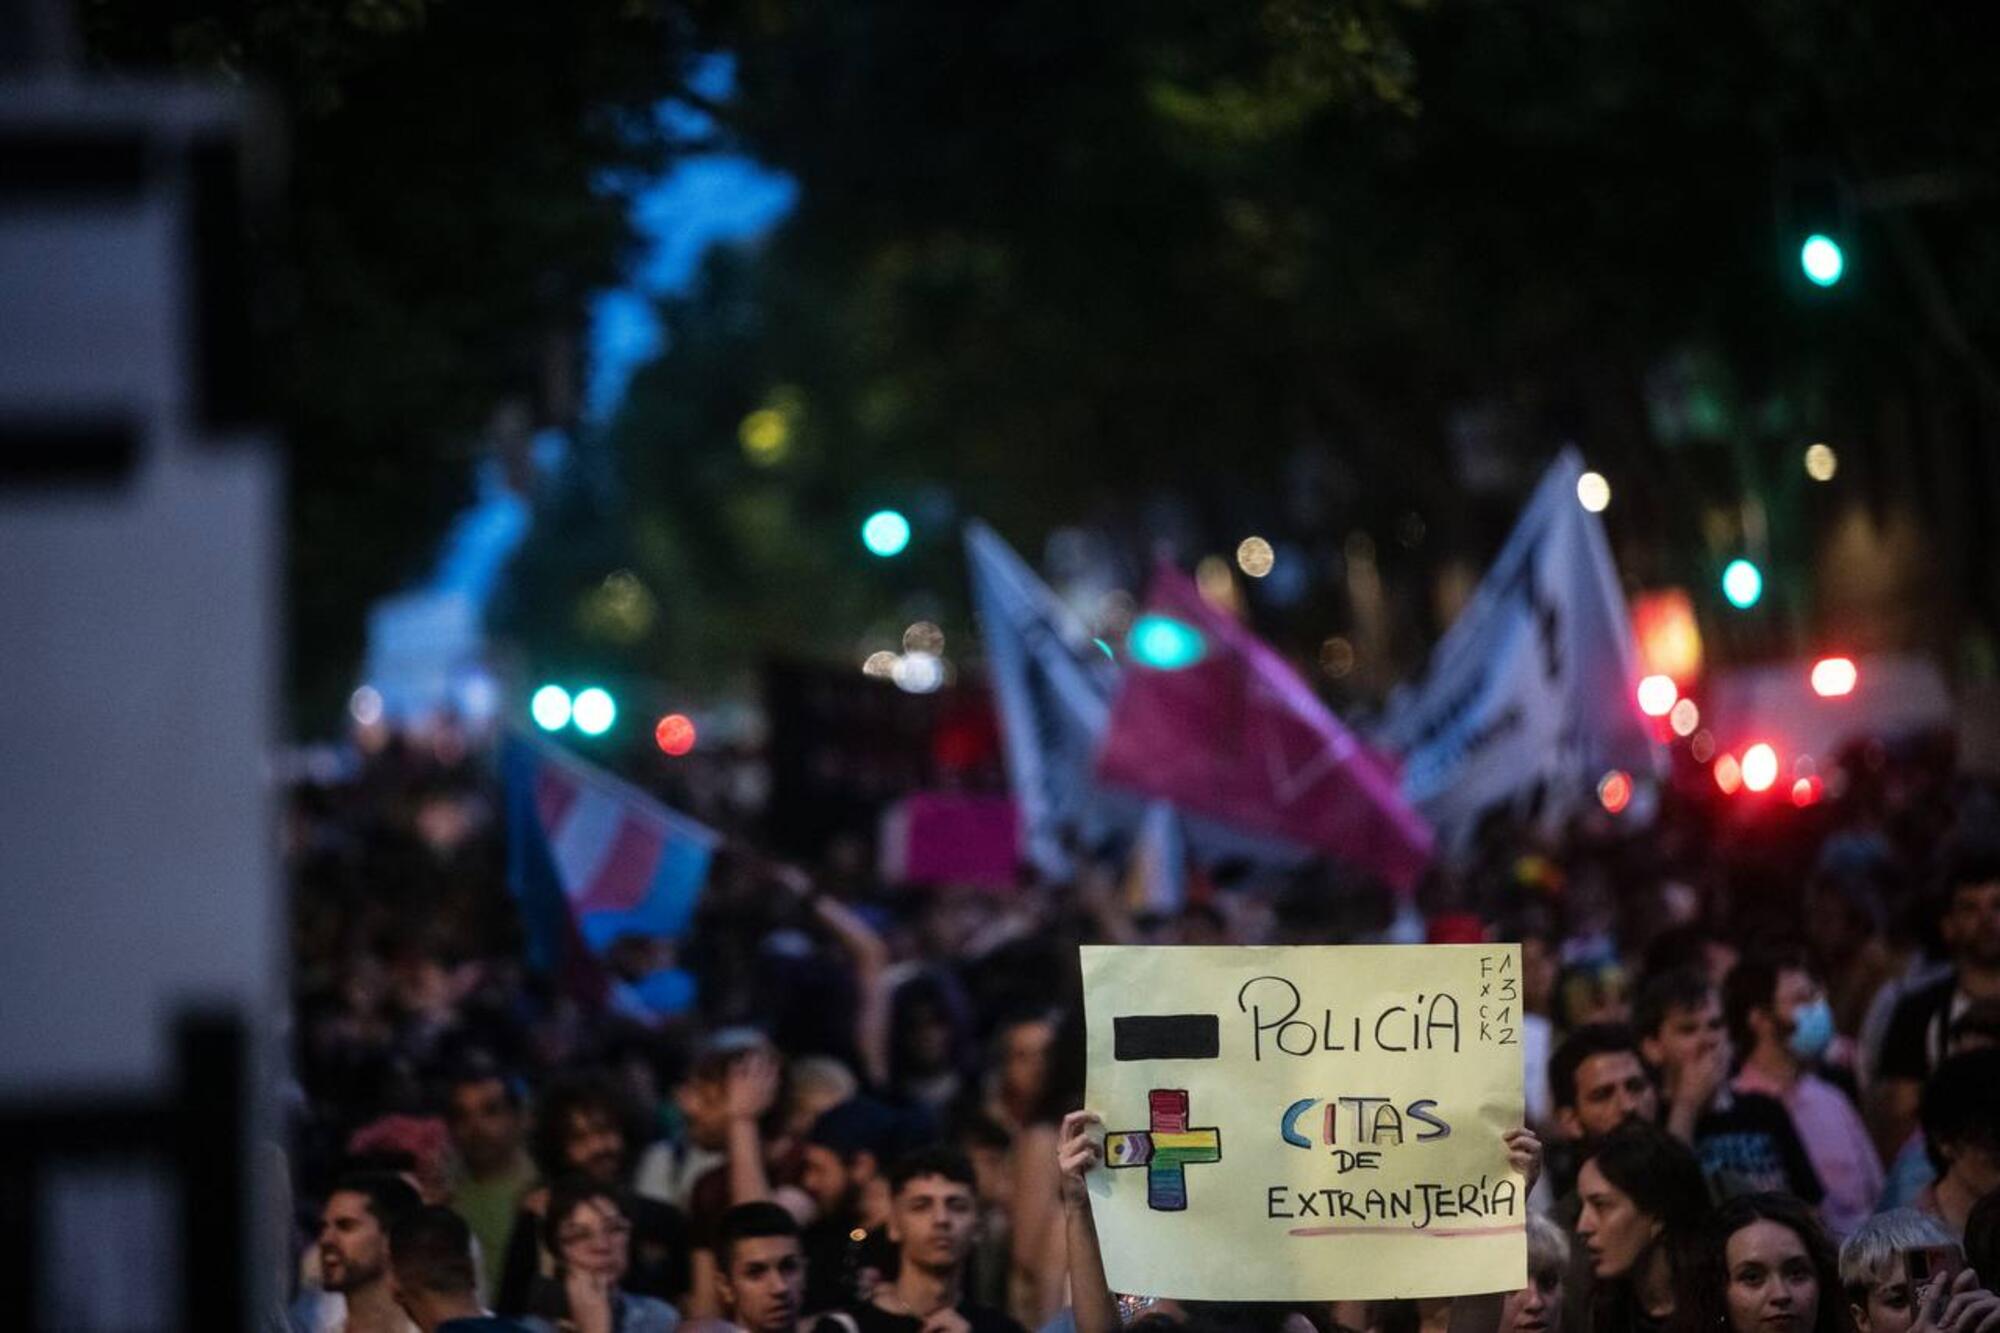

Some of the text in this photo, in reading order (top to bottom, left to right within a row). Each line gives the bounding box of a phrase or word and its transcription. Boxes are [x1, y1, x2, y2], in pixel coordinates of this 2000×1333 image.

[1281, 1097, 1450, 1149] CITAS
[1332, 1150, 1382, 1173] DE
[1268, 1175, 1515, 1228] EXTRANJERÍA
